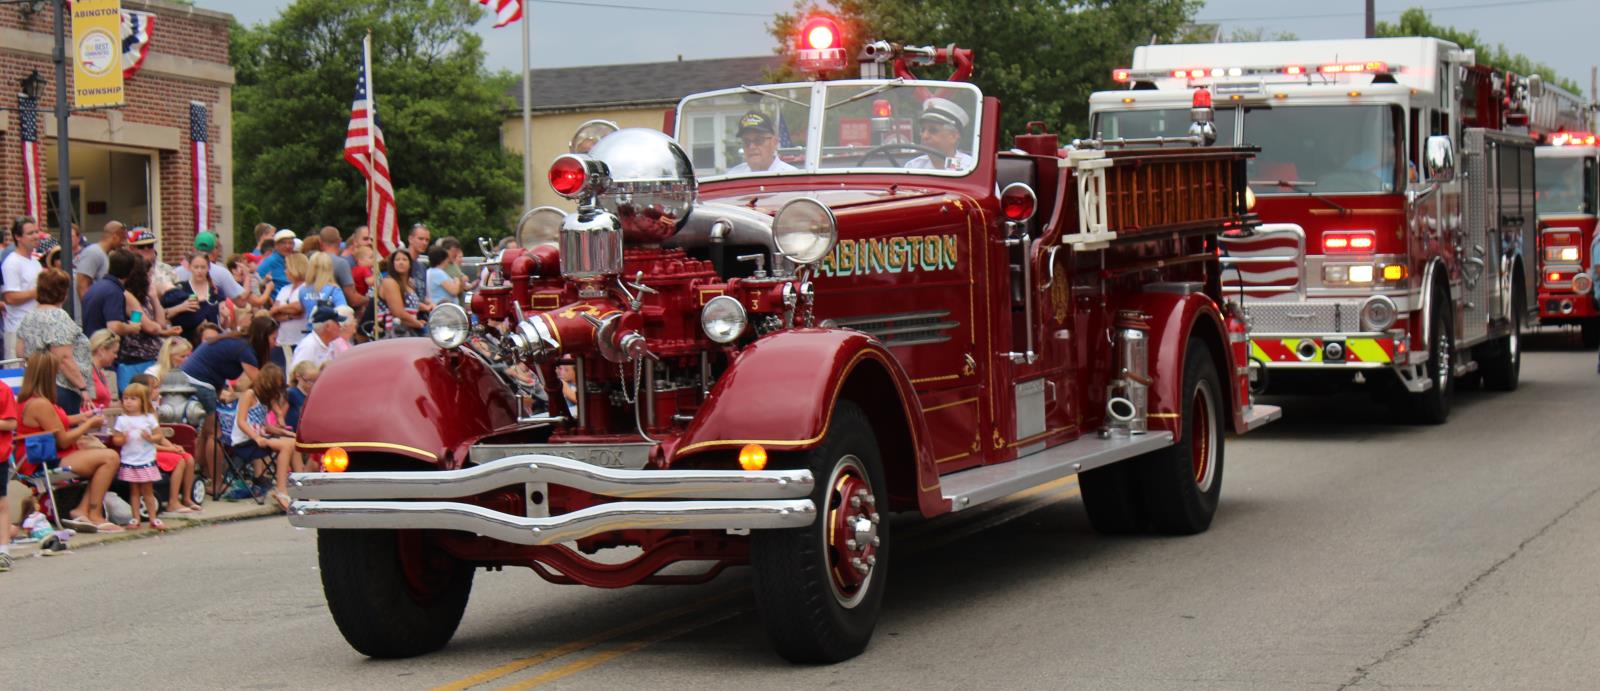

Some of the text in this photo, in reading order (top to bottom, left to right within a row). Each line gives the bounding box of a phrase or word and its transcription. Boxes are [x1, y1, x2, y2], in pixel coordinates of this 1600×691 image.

[74, 7, 119, 18] ABINGTON
[77, 86, 122, 97] TOWNSHIP
[813, 234, 958, 277] ABINGTON
[488, 304, 496, 315] 2
[751, 299, 759, 310] 3
